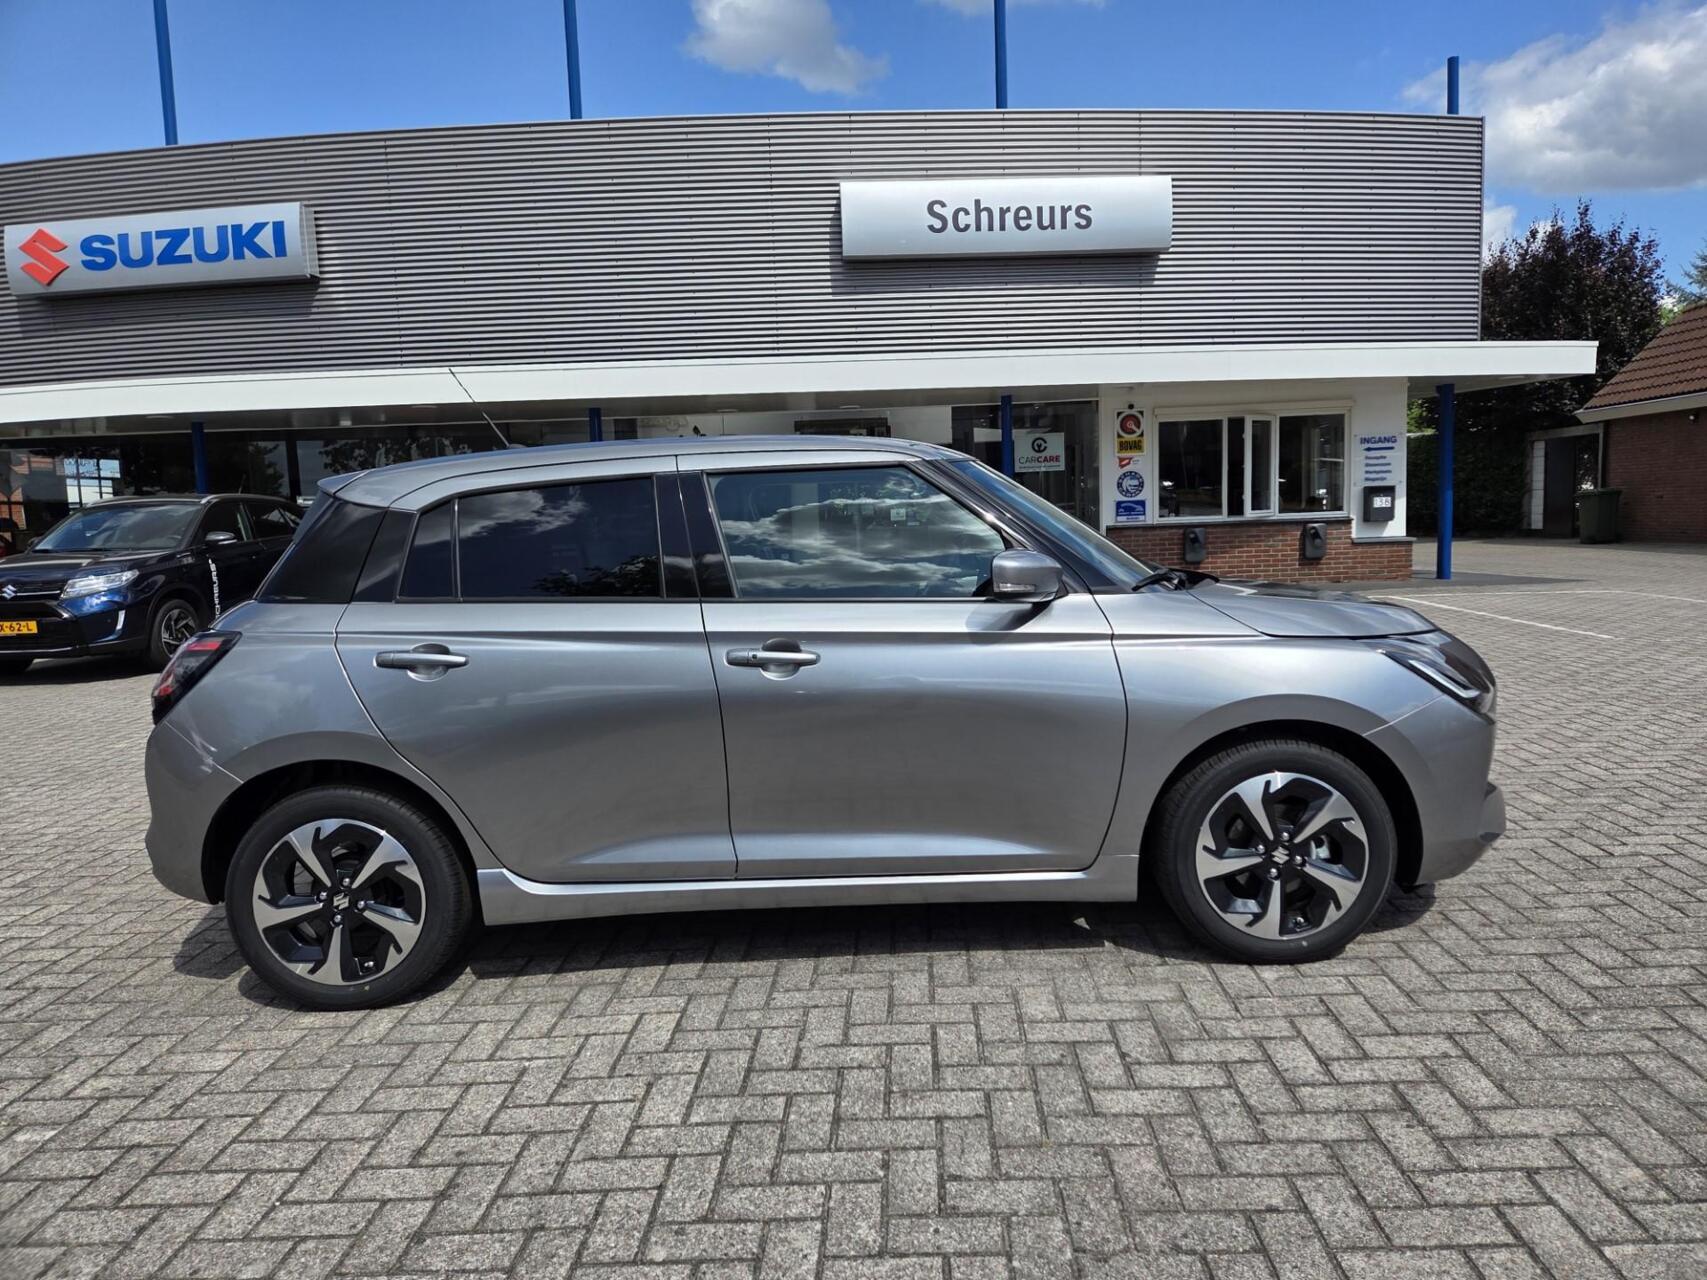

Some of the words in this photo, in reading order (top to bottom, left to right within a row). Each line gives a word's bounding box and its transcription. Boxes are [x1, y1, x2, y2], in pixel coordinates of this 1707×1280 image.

[926, 199, 1093, 234] Schreurs
[79, 220, 288, 271] SUZUKI
[1119, 440, 1142, 451] BOVAG
[1360, 435, 1397, 445] INGANG
